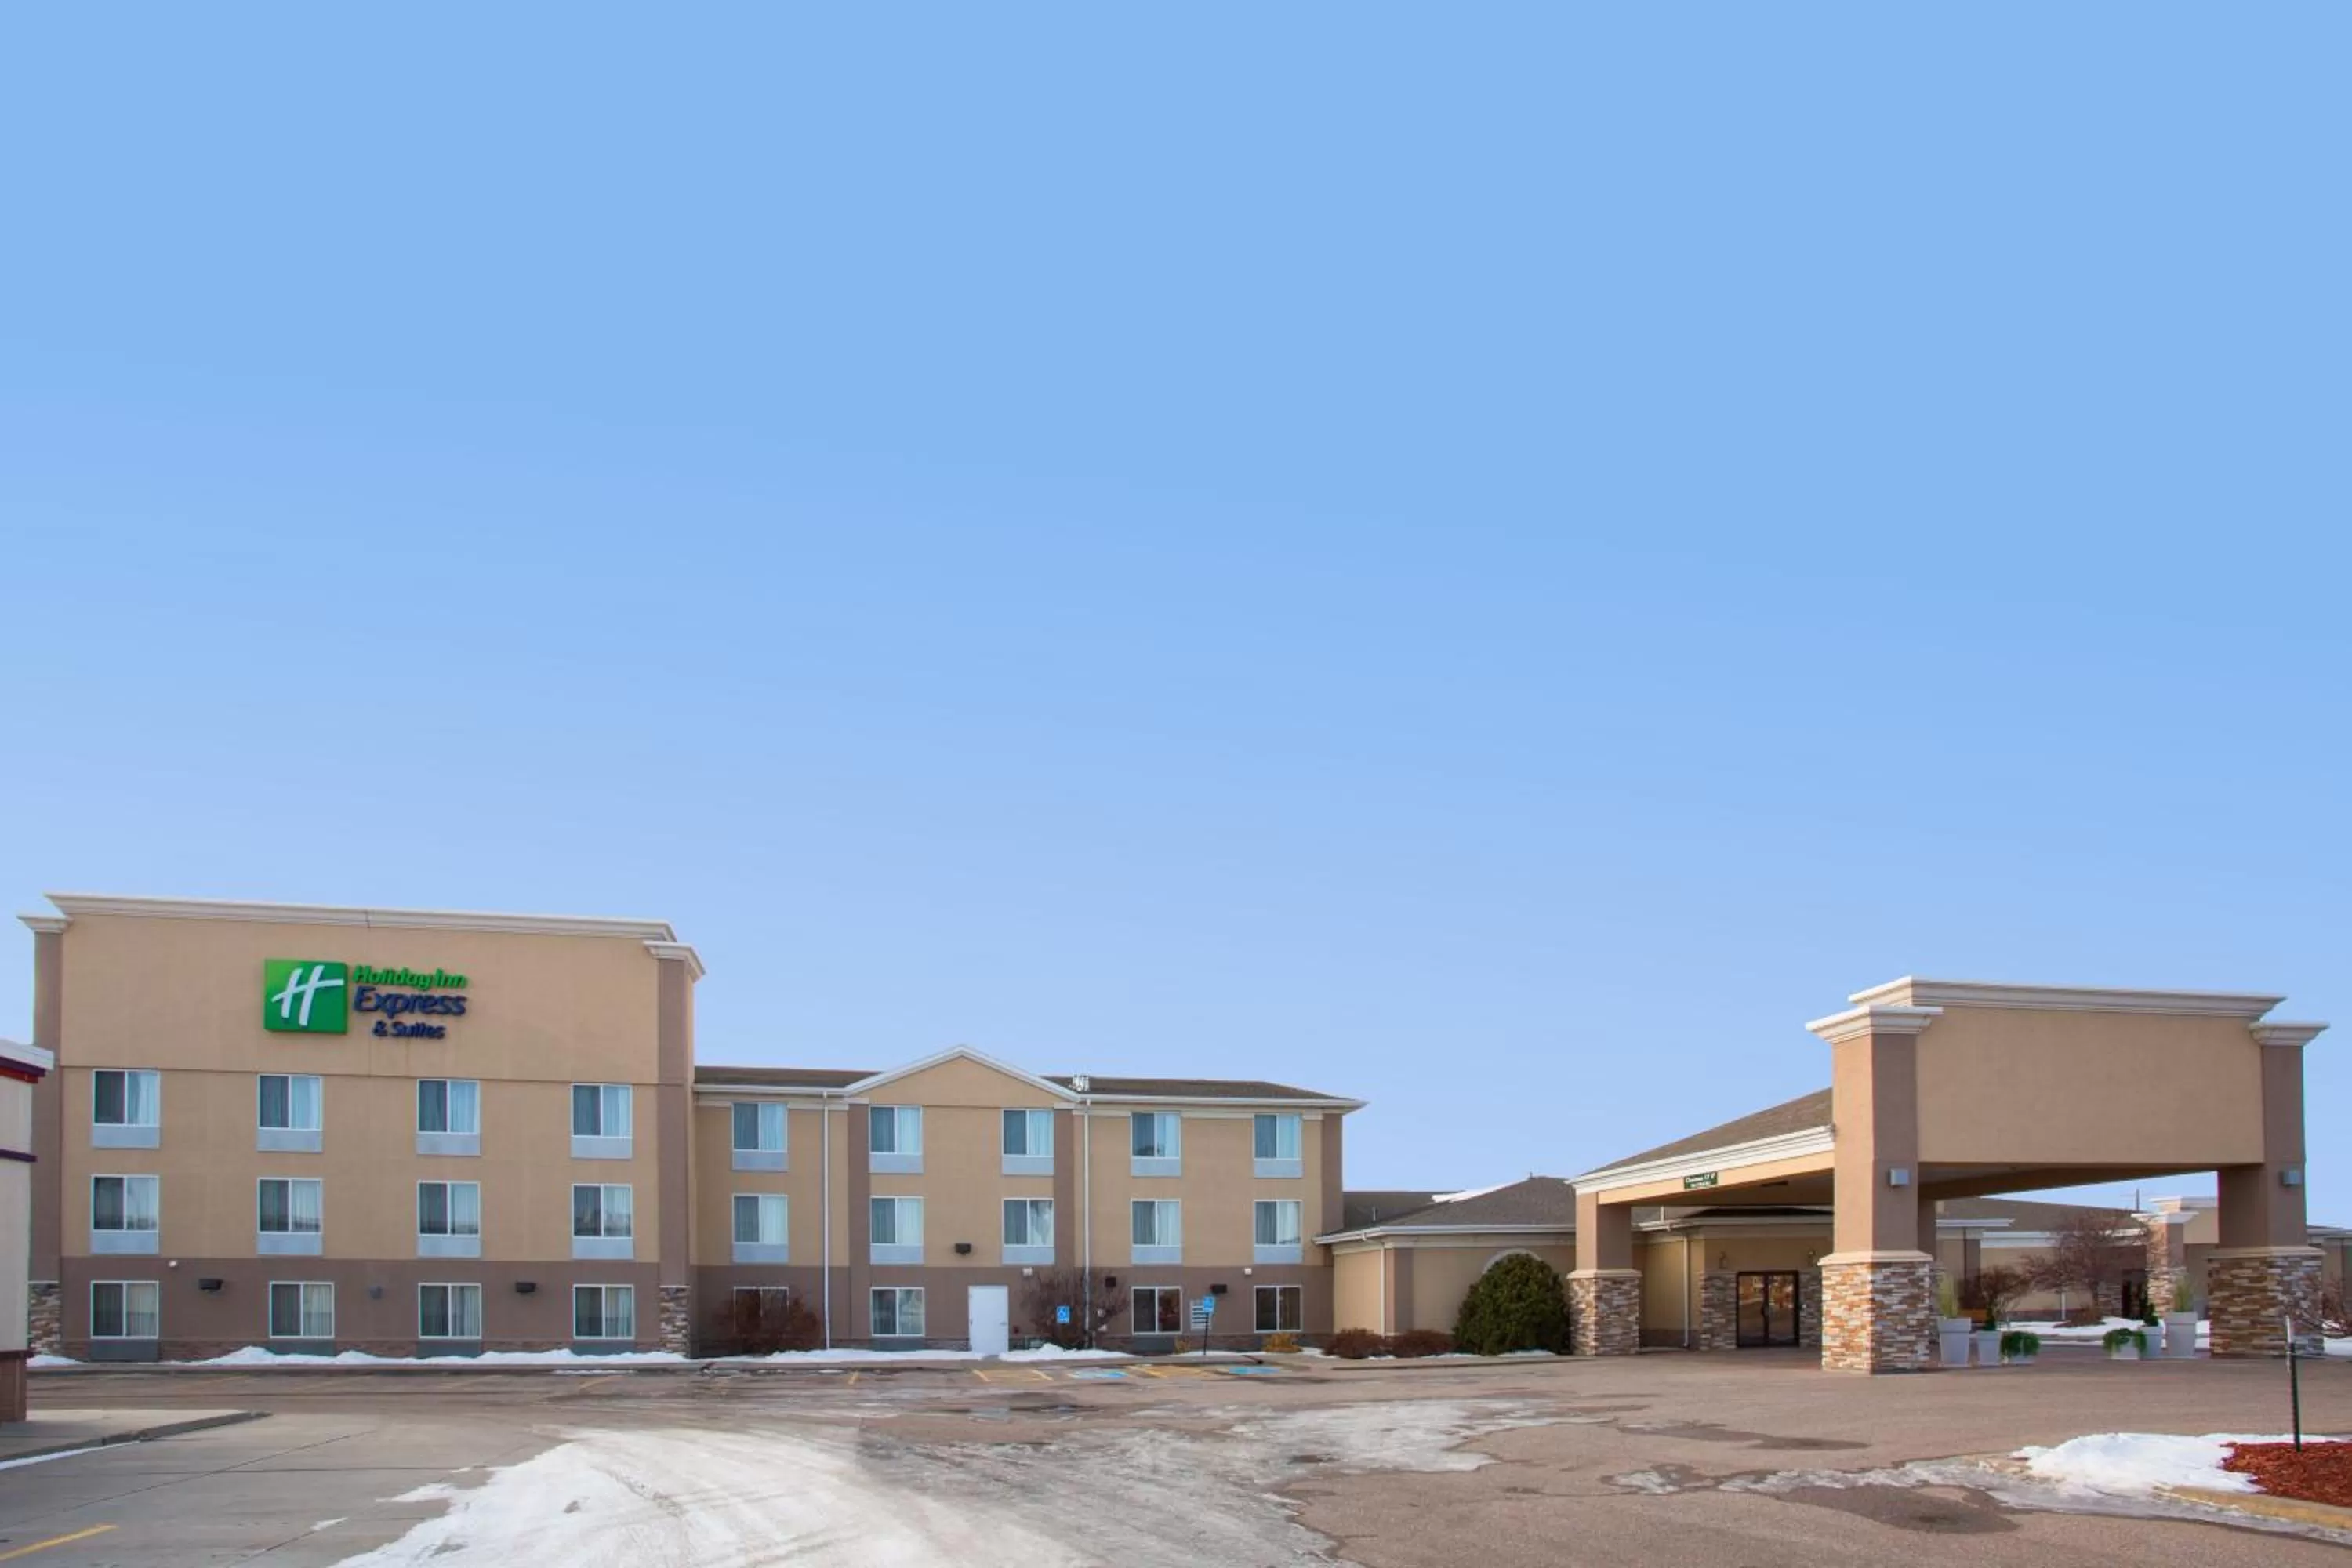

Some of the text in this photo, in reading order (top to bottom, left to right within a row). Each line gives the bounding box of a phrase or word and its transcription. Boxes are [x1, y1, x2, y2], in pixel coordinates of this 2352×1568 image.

[353, 965, 468, 991] Holiday Inn
[354, 985, 467, 1018] Express
[372, 1020, 446, 1040] & Suites
